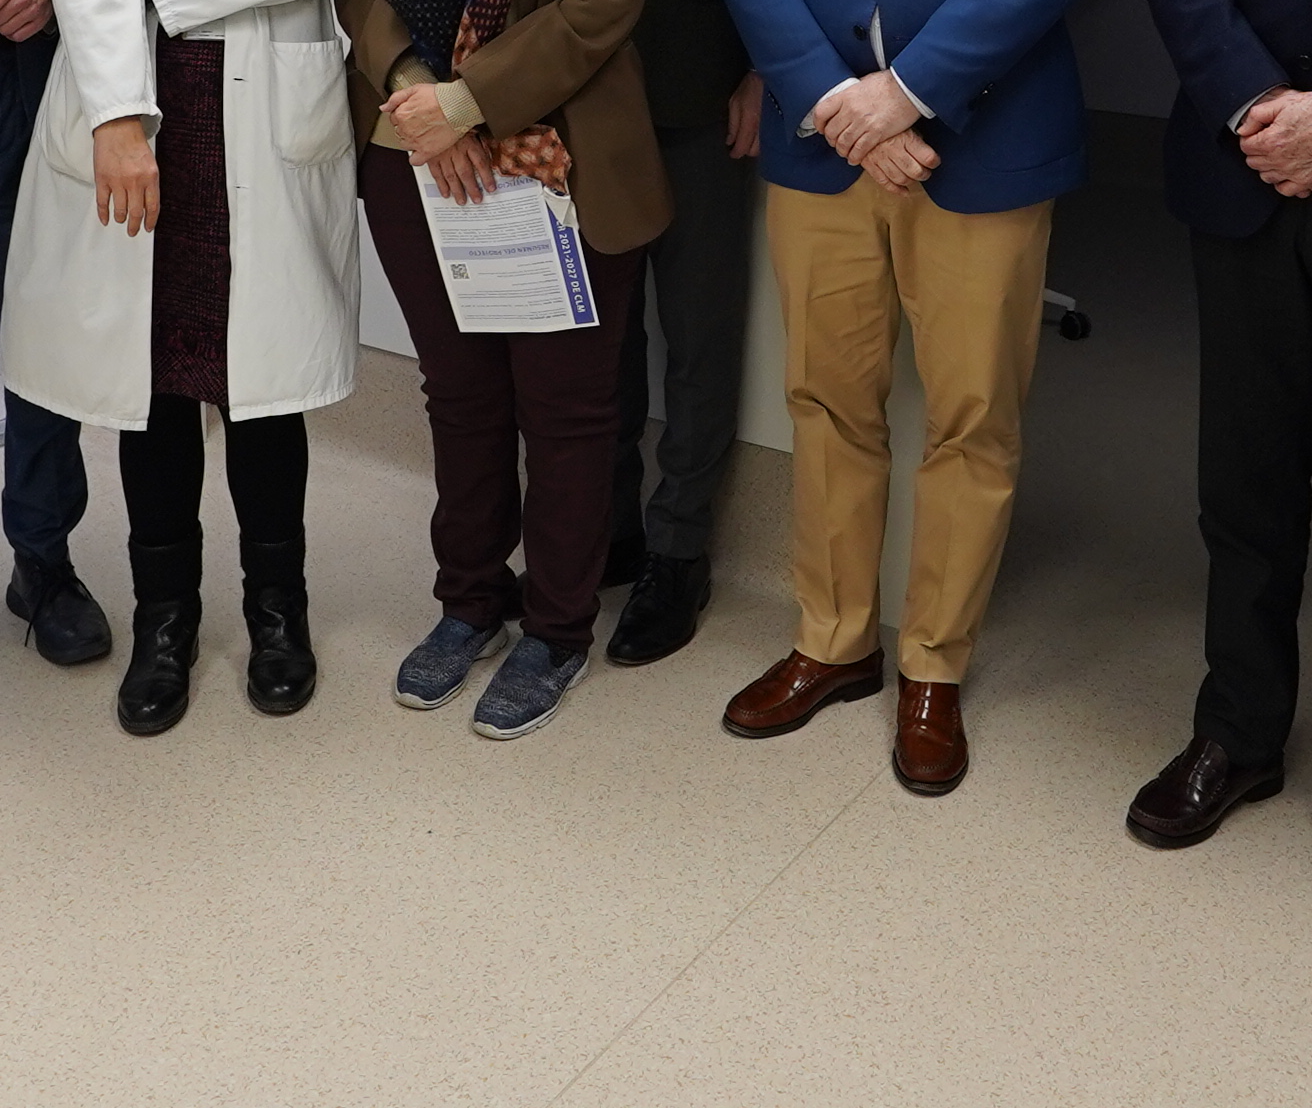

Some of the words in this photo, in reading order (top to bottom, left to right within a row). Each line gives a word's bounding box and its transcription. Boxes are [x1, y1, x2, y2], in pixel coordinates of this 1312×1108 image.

[559, 233, 577, 279] 2021-2027
[570, 281, 582, 293] DE
[574, 294, 586, 313] CLM
